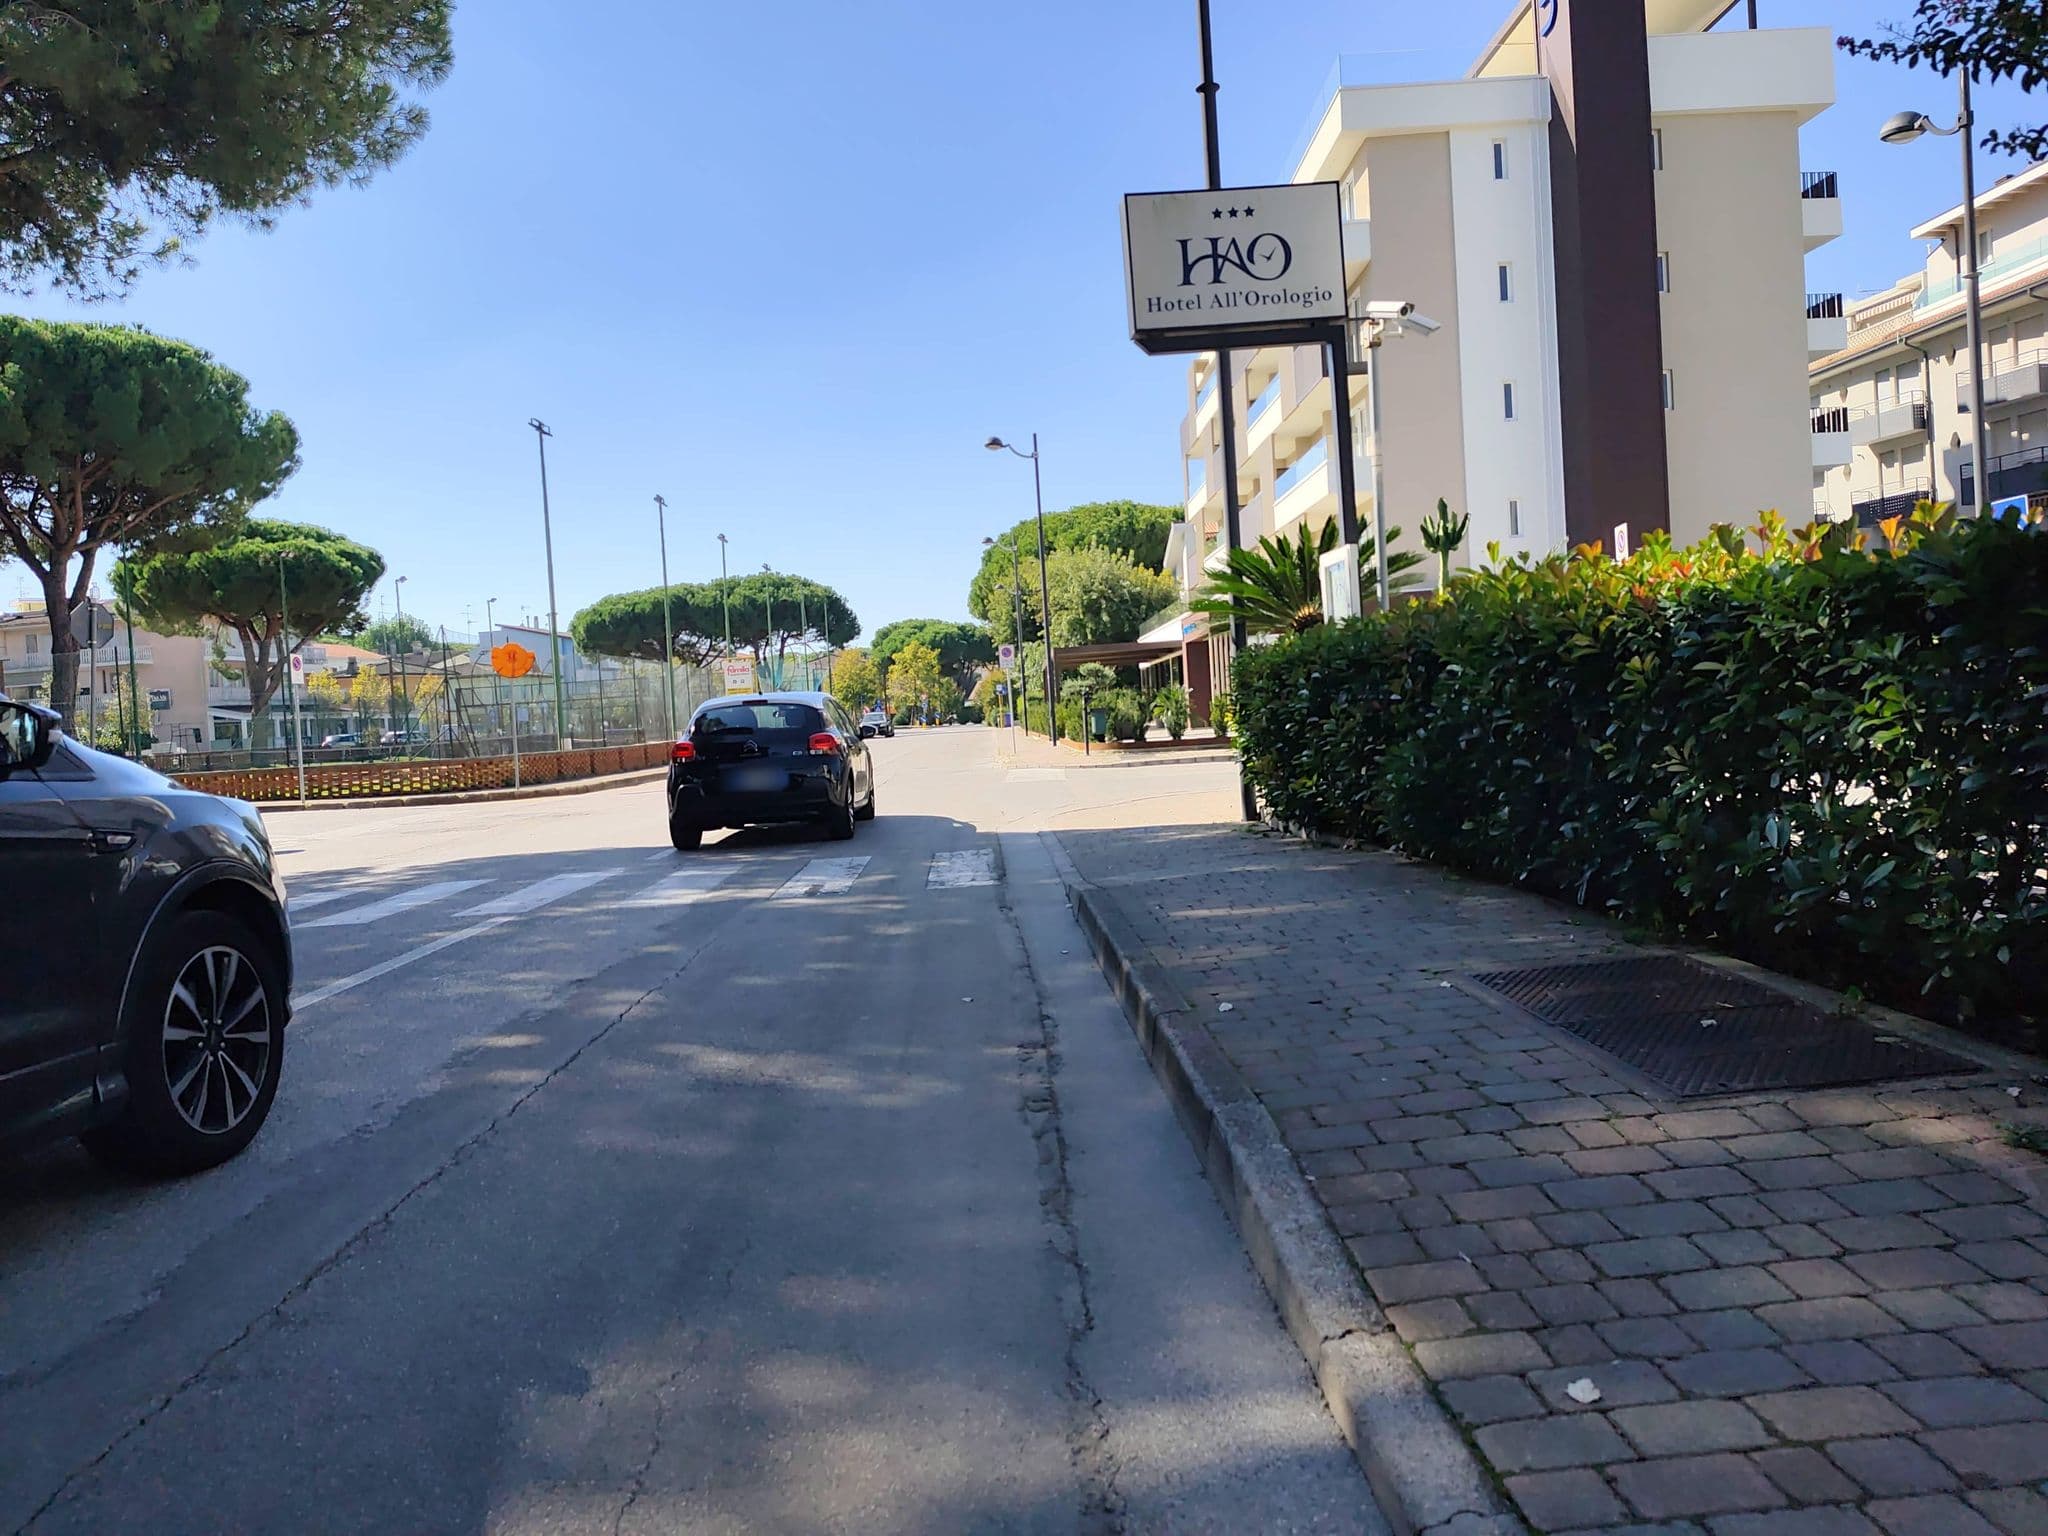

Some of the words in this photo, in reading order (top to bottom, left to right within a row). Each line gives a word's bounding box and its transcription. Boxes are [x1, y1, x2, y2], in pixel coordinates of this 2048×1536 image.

[1176, 232, 1292, 286] HAO
[1147, 294, 1201, 312] Hotel
[1210, 287, 1332, 308] All'Orologio
